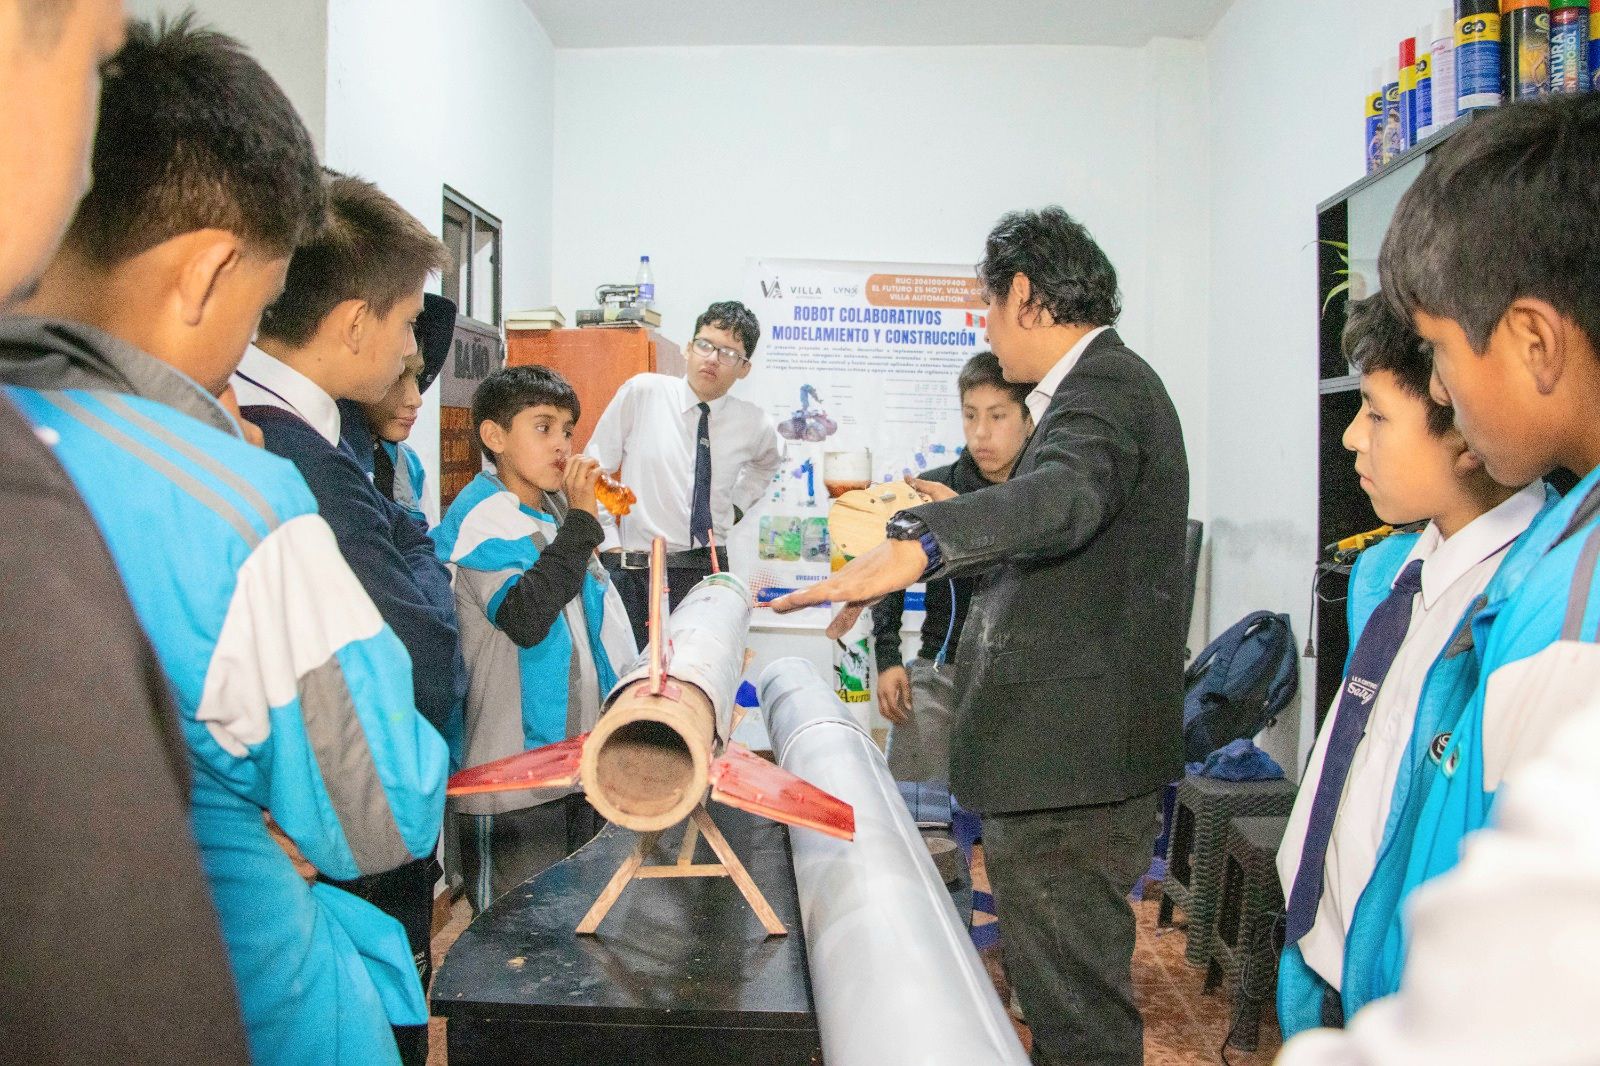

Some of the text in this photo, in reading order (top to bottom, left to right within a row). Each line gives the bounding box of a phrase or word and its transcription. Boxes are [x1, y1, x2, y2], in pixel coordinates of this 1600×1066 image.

[1566, 30, 1577, 78] AEROSOL
[790, 286, 822, 295] VILLA
[871, 284, 880, 292] EL
[882, 285, 912, 293] FUTURO
[946, 287, 969, 295] VIAJA
[912, 294, 964, 303] AUTOMATION
[793, 305, 942, 326] ROBOT COLABORATIVOS
[772, 325, 976, 347] MODELAMIENTO Y CONSTRUCCIÓN
[454, 336, 490, 380] BAÑO
